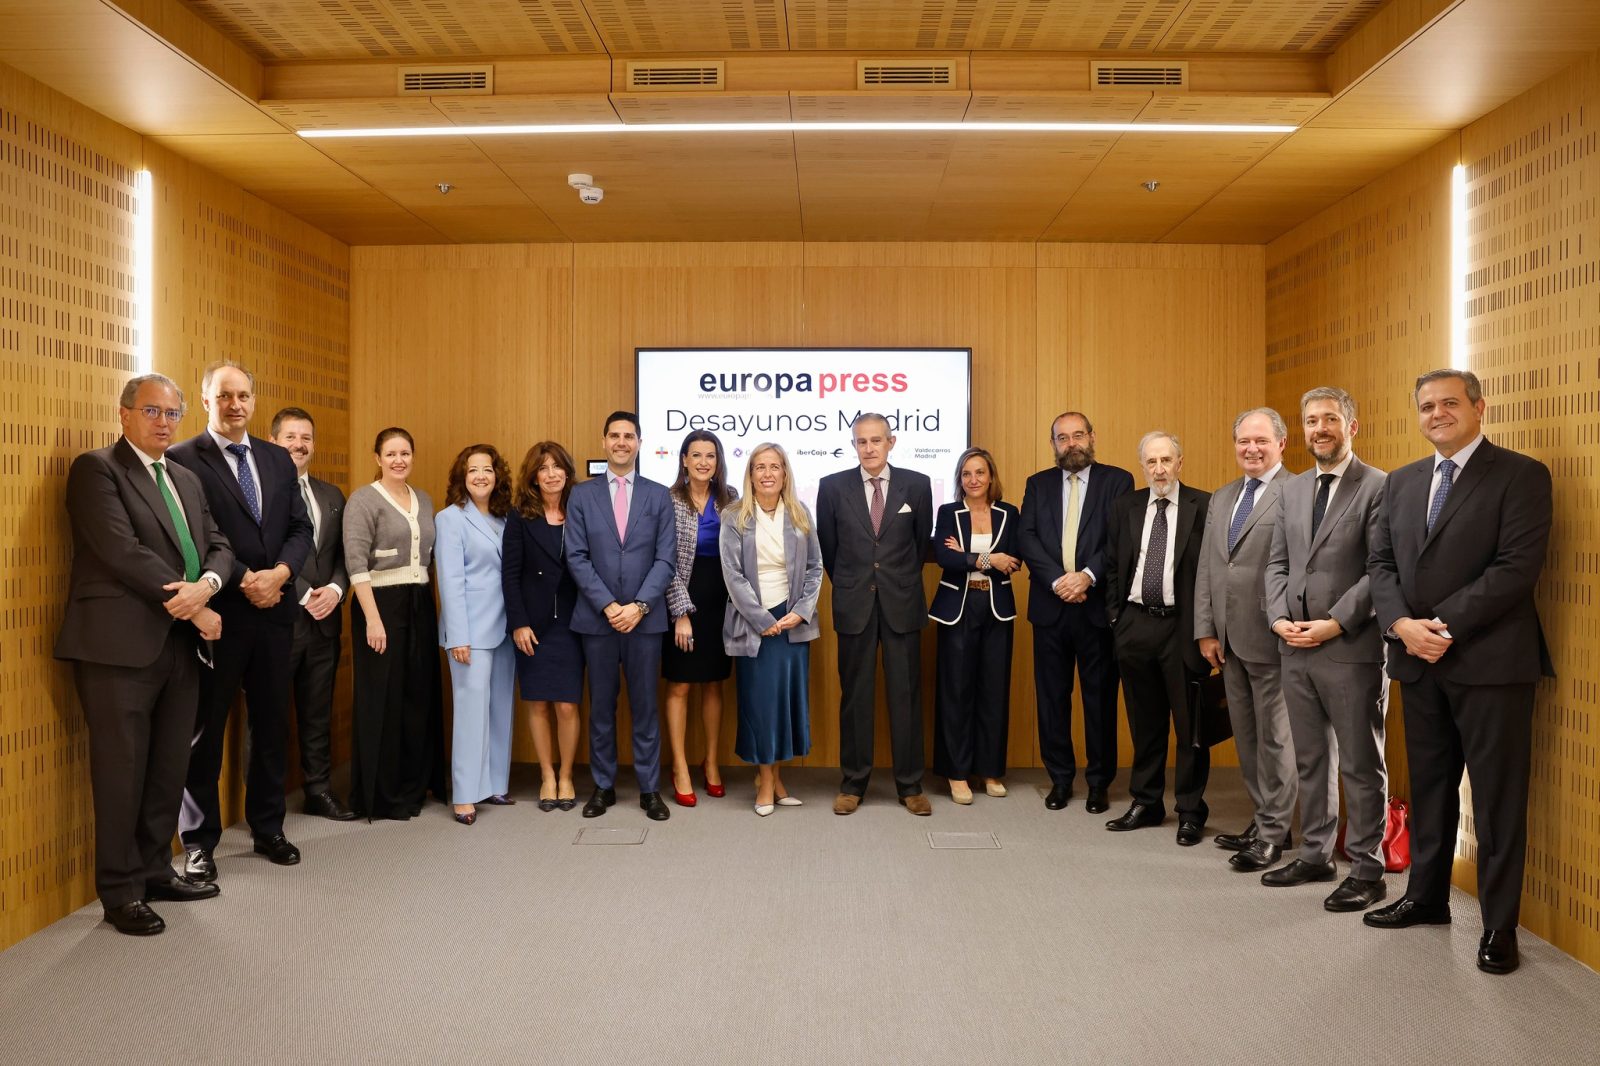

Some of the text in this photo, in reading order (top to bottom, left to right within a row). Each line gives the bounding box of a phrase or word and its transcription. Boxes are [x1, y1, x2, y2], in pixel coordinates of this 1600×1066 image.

[699, 372, 909, 399] europa press
[666, 408, 940, 437] Desayunos Mdrid
